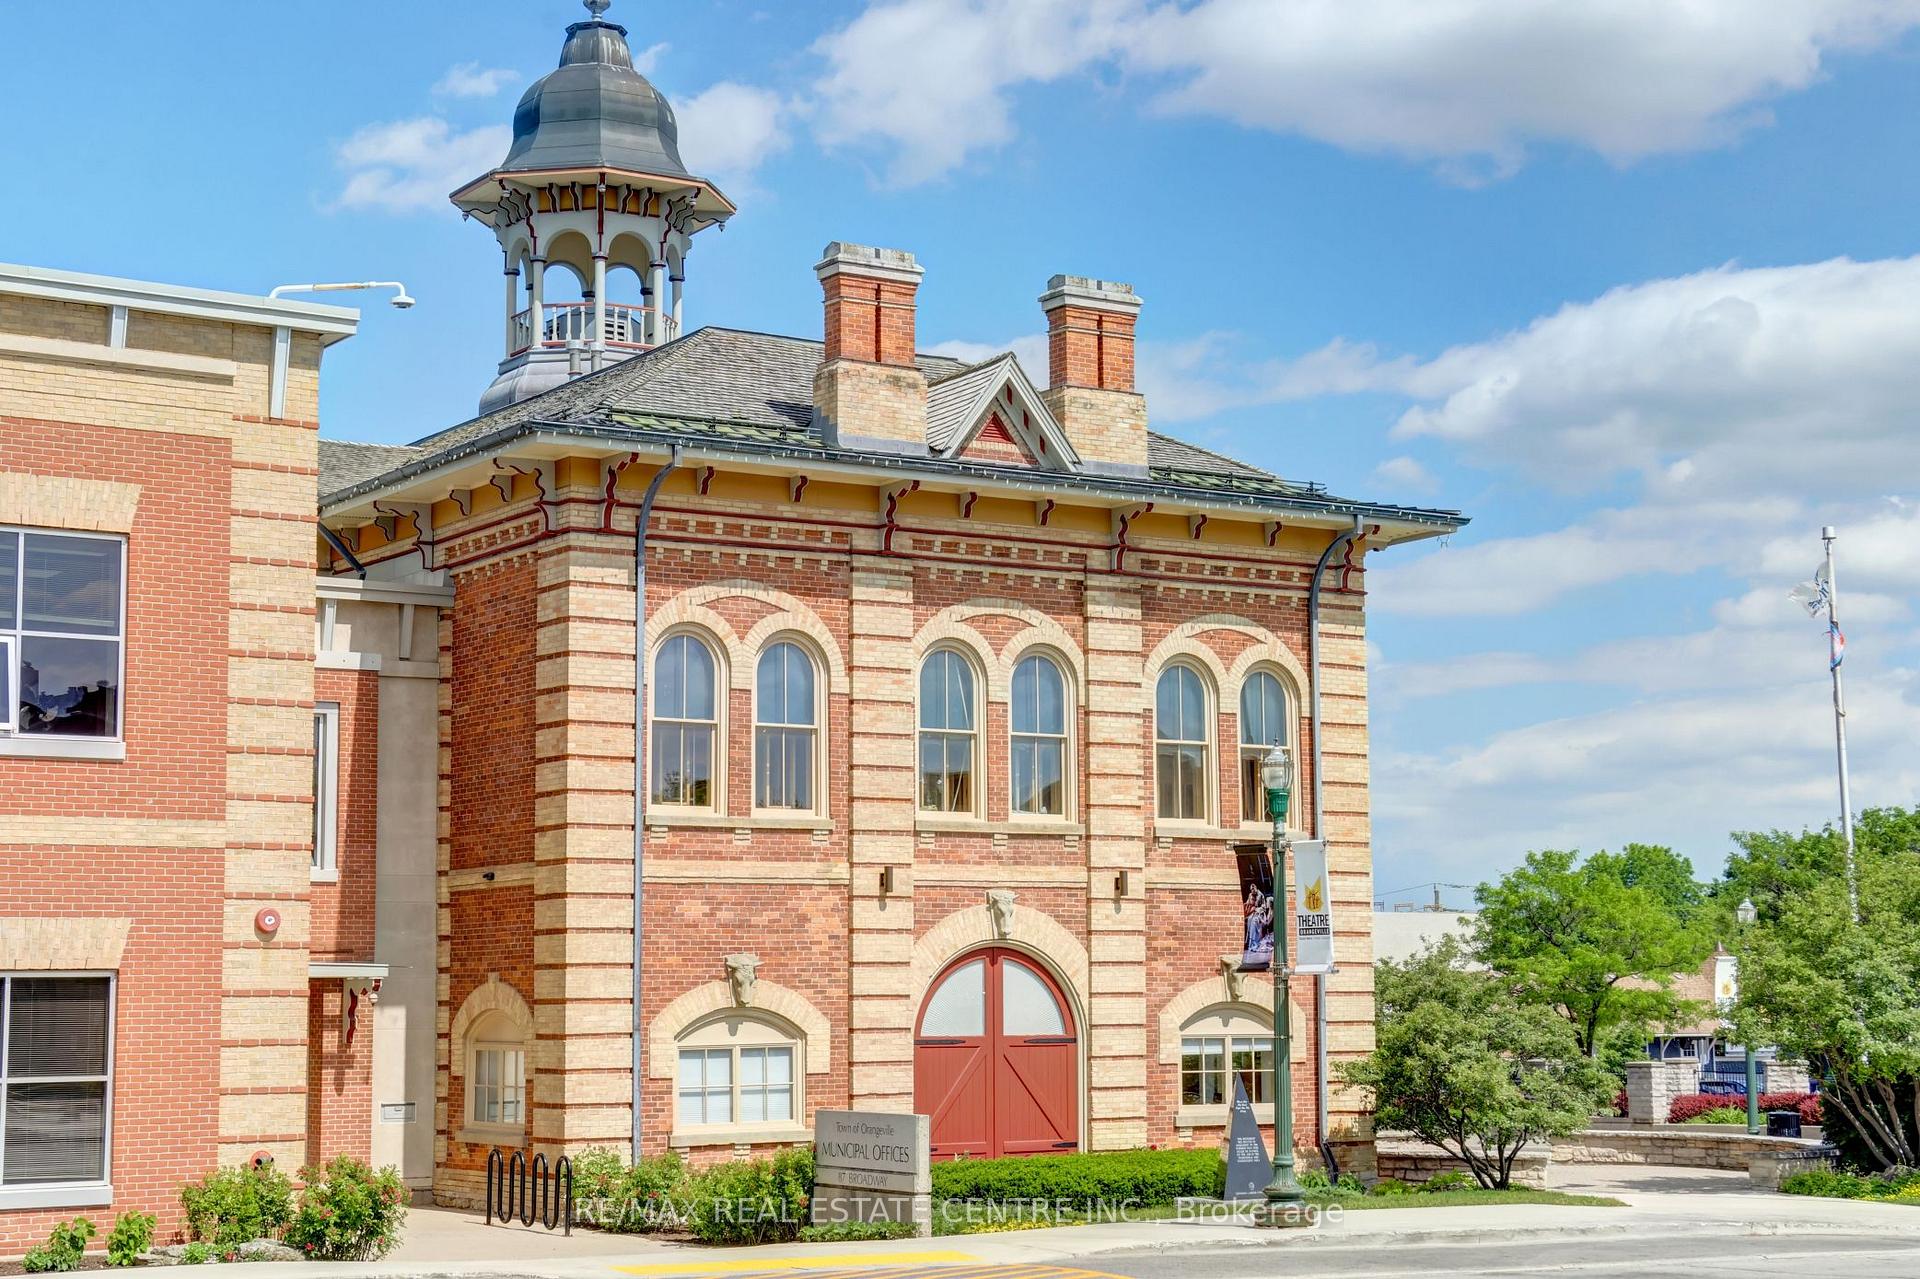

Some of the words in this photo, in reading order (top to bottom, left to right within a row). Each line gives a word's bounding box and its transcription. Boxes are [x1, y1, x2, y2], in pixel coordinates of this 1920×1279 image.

[1298, 914, 1329, 927] THEATRE
[836, 1122, 851, 1134] Town
[853, 1122, 860, 1134] of
[861, 1123, 894, 1138] Orangeville
[822, 1142, 870, 1160] MUNICIPAL
[872, 1144, 909, 1162] OFFICES
[849, 1172, 888, 1187] BROADWAY
